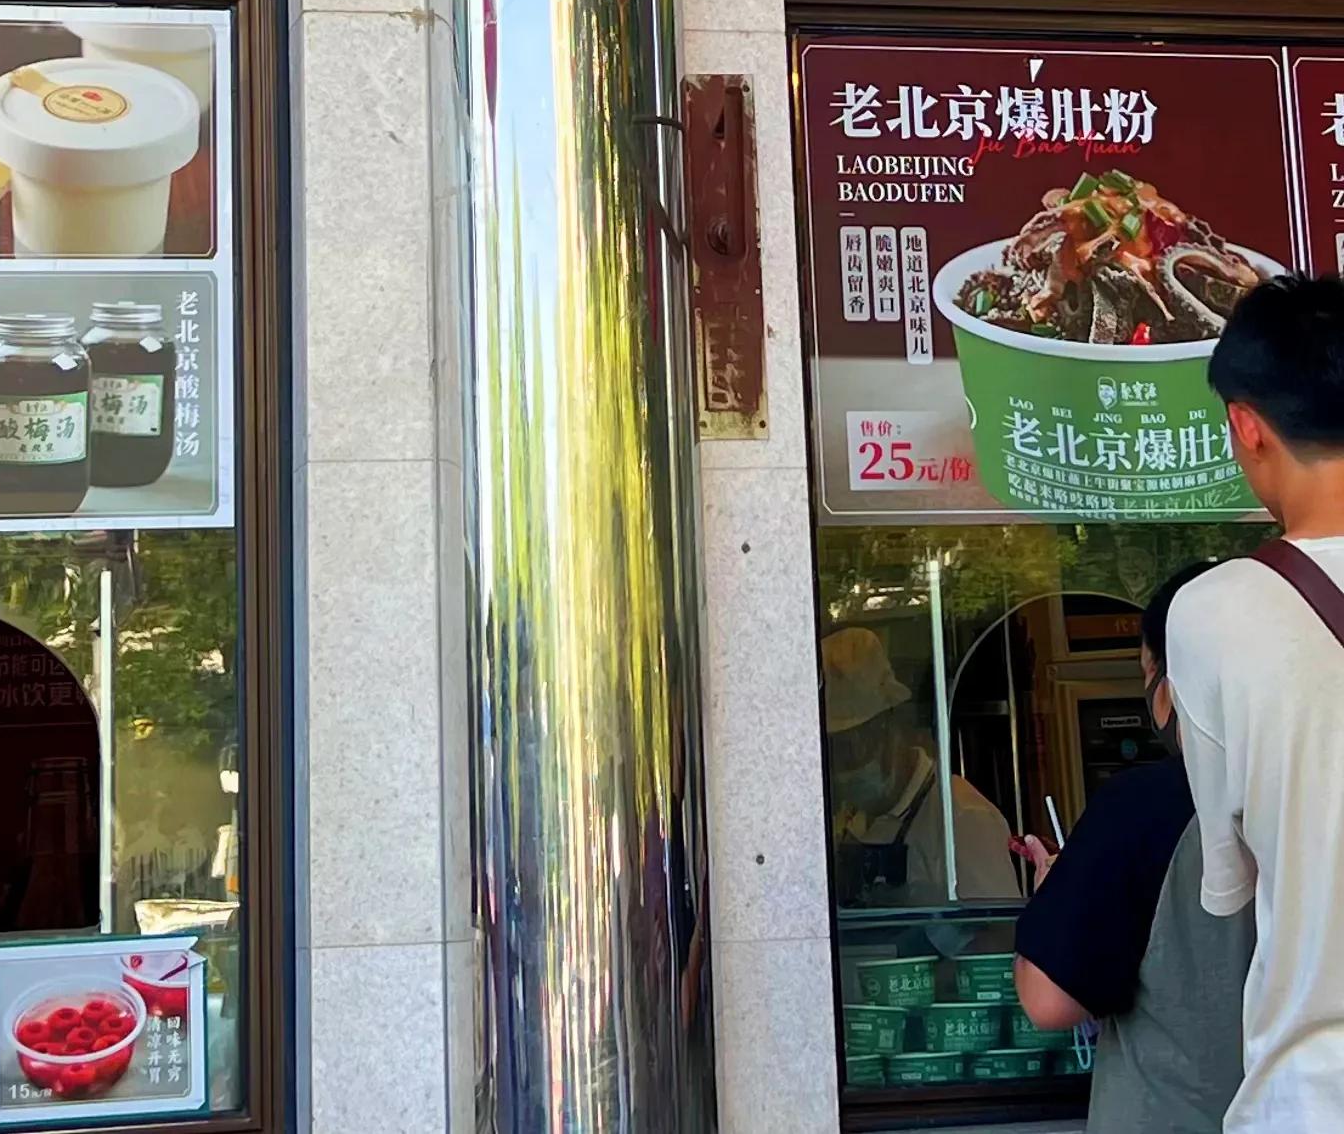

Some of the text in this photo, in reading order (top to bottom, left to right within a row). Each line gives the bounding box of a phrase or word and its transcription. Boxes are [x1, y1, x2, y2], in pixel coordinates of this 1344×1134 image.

[829, 82, 1158, 144] 老北京爆肚粉
[836, 154, 975, 179] LAOBEIJING
[838, 182, 965, 203] BAODUFEN
[845, 234, 867, 315] 唇齿留香
[875, 234, 896, 314] 脆嫩爽口
[904, 233, 930, 356] 地道北京味儿
[92, 392, 149, 416] 梅汤
[174, 291, 201, 457] 老北京酸梅汤
[858, 441, 972, 483] 25元/份
